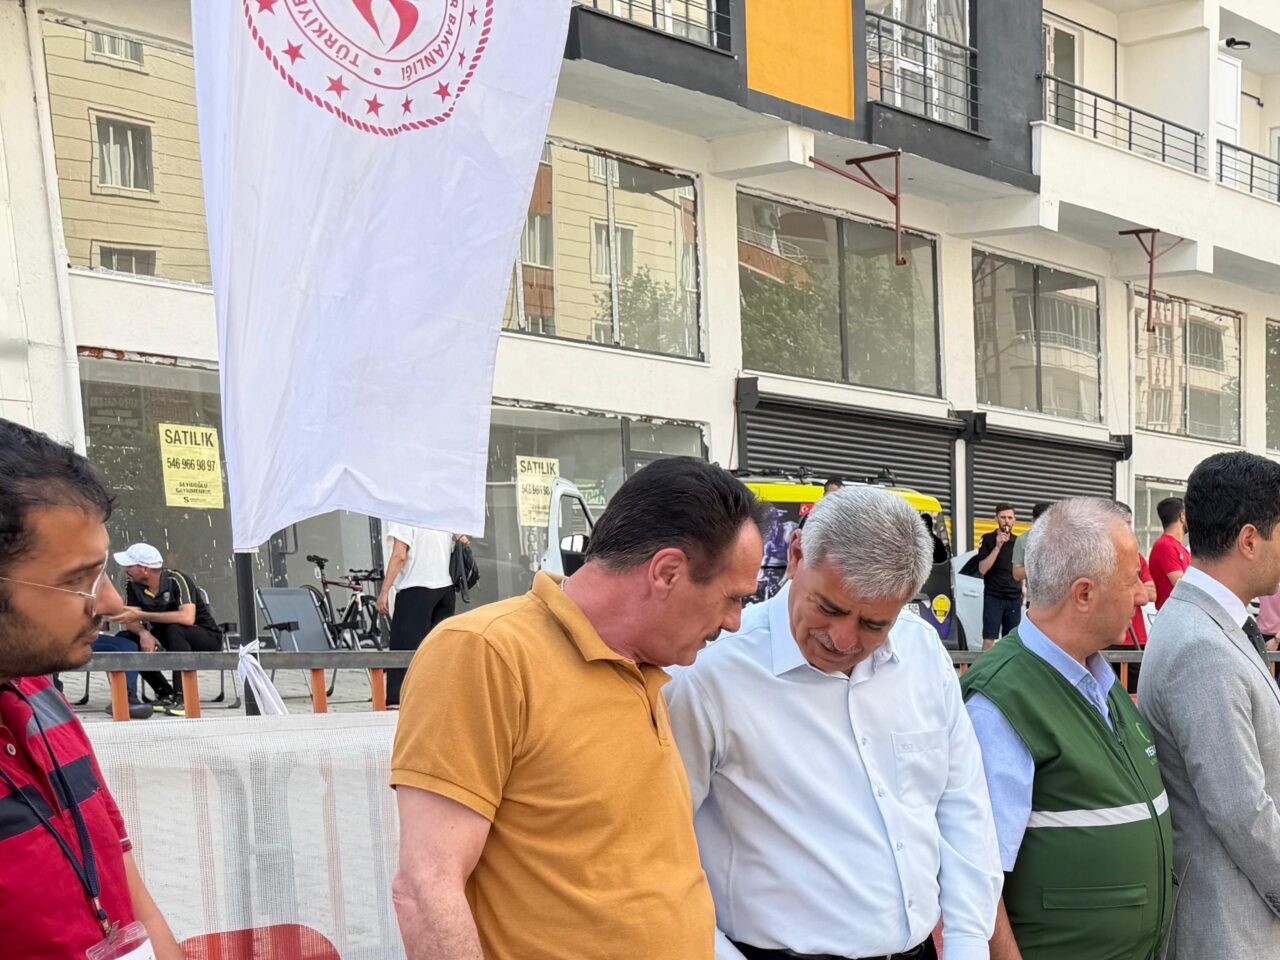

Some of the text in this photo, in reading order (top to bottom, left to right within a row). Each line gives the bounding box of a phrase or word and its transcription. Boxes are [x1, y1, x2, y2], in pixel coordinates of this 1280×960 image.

[164, 429, 214, 447] SATILIK
[166, 457, 181, 470] 546
[207, 460, 216, 472] 97
[520, 460, 557, 475] SATILIK
